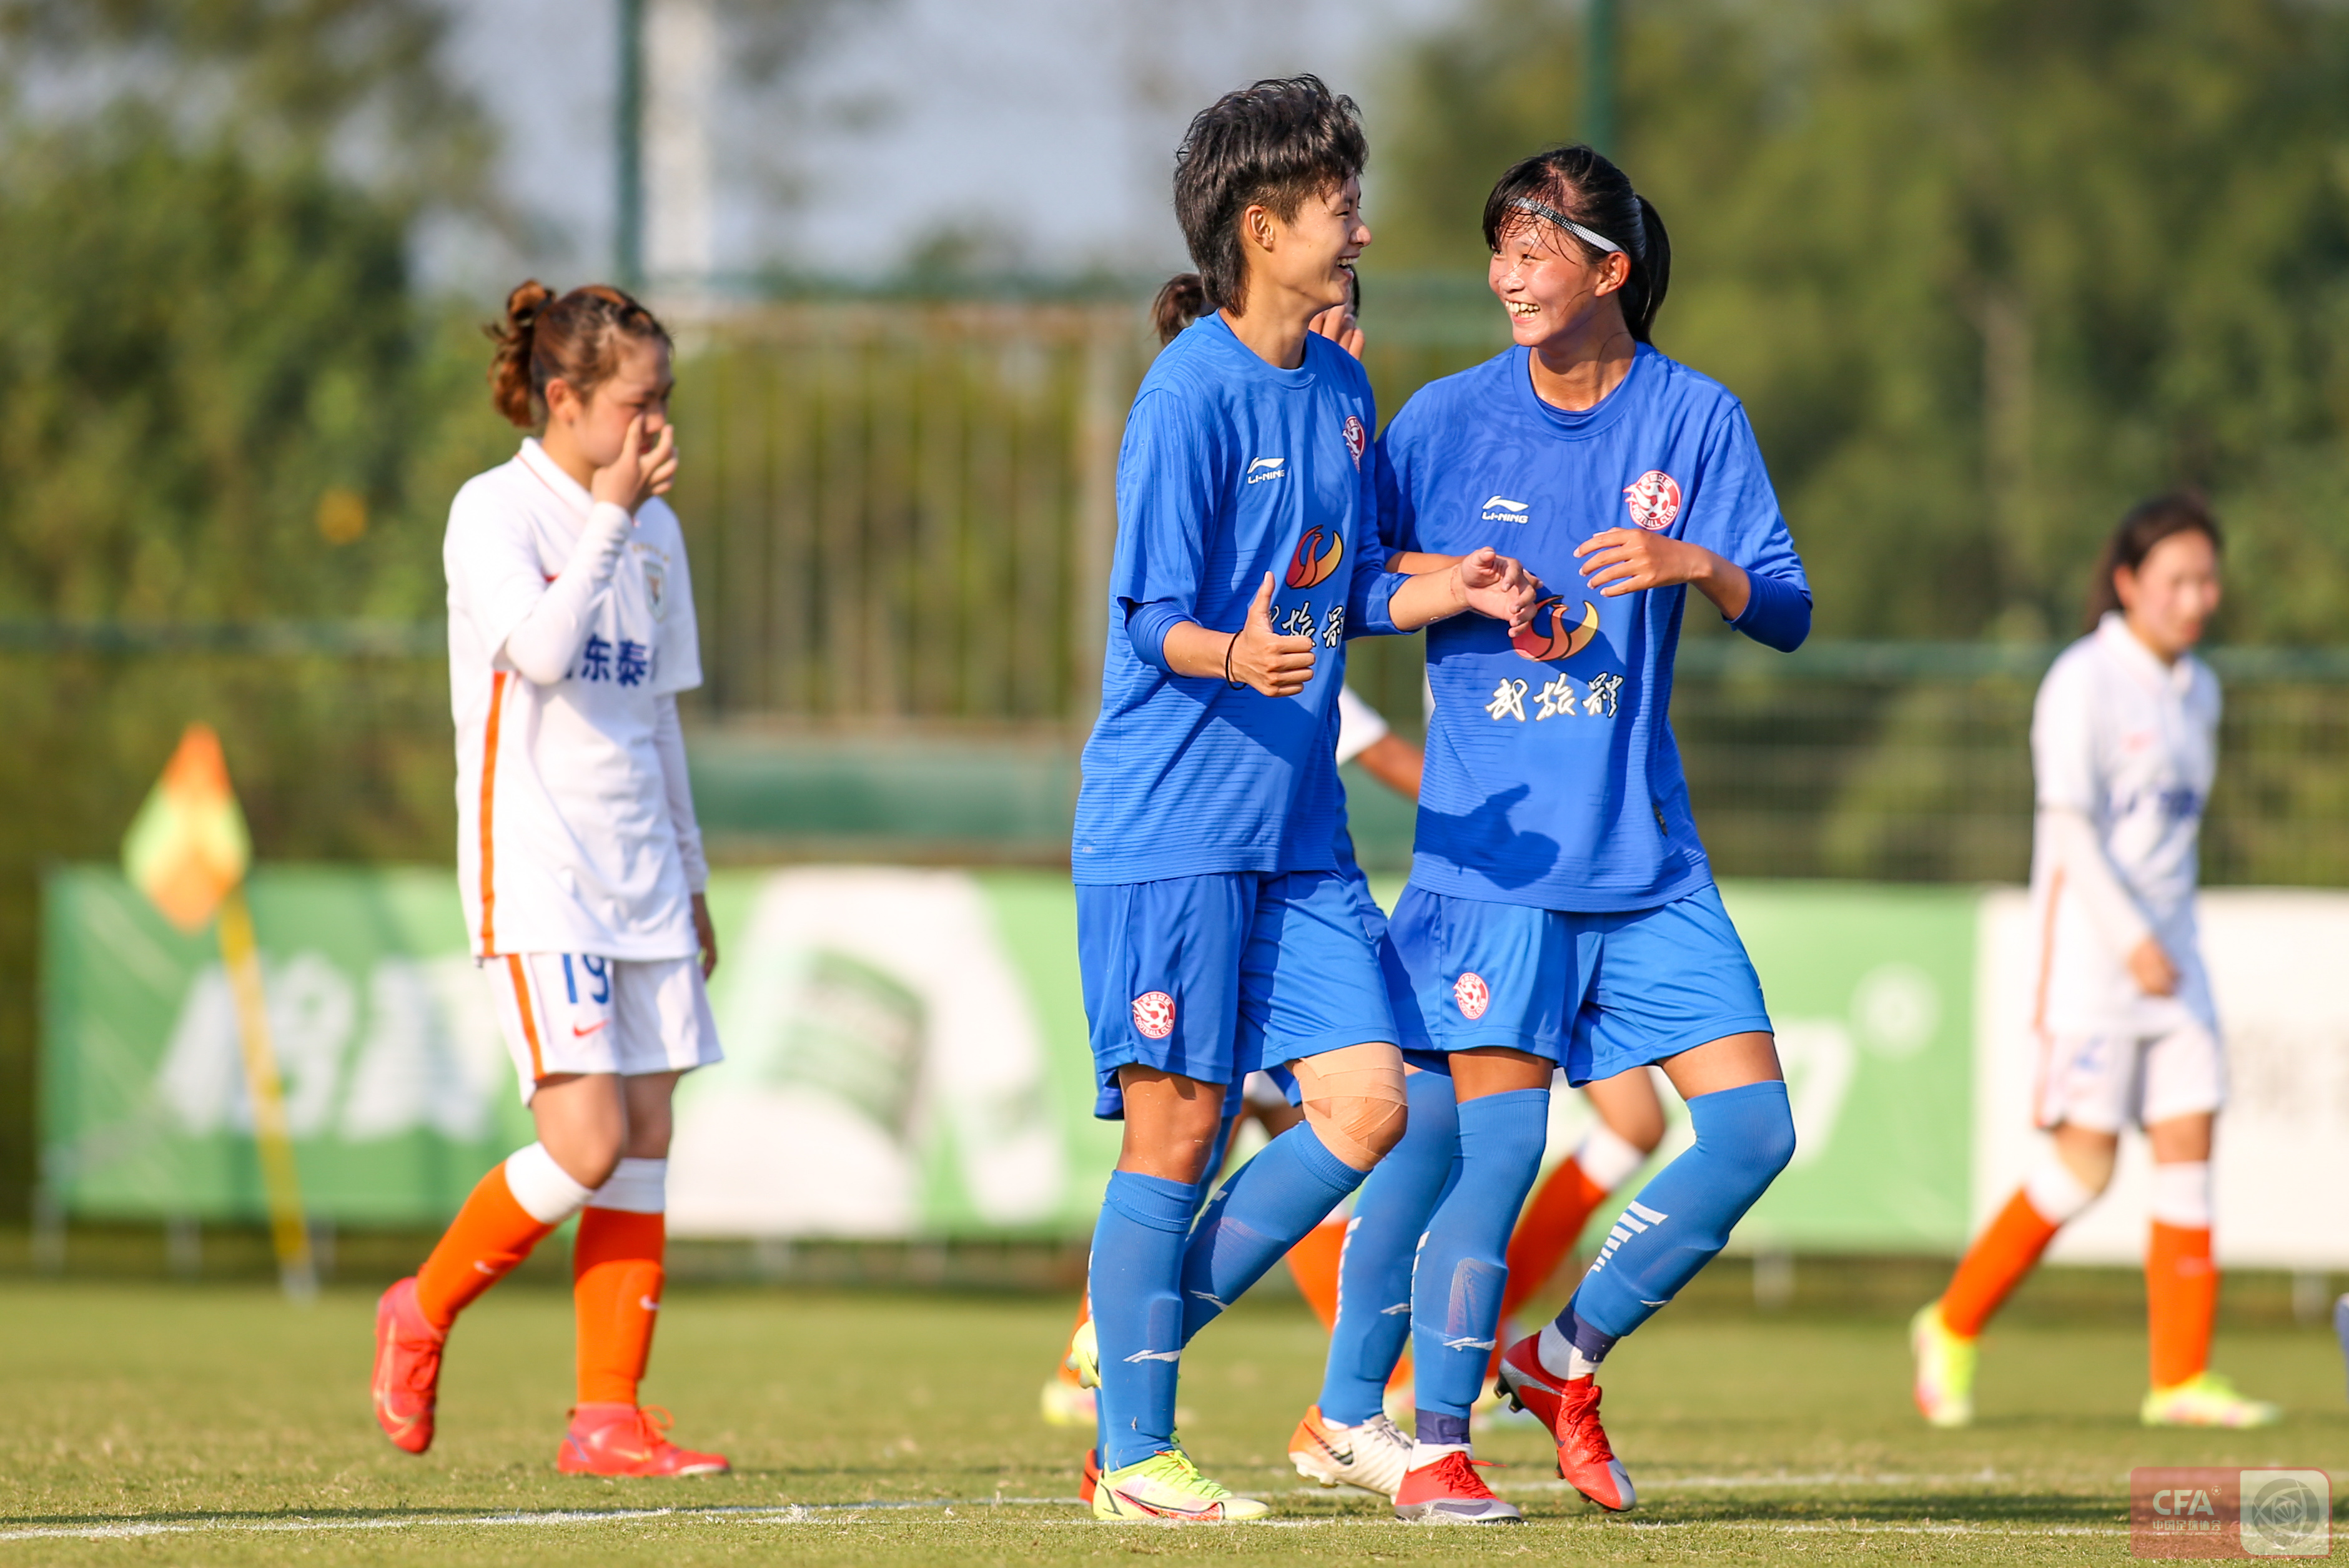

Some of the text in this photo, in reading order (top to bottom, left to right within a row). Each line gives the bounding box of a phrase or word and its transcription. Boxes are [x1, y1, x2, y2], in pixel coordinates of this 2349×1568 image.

[1248, 469, 1285, 484] LI-NING
[1481, 511, 1529, 524] LI-NING
[1659, 505, 1676, 524] CLUB
[562, 953, 610, 1004] 19
[1136, 1015, 1162, 1036] FOOTBALL
